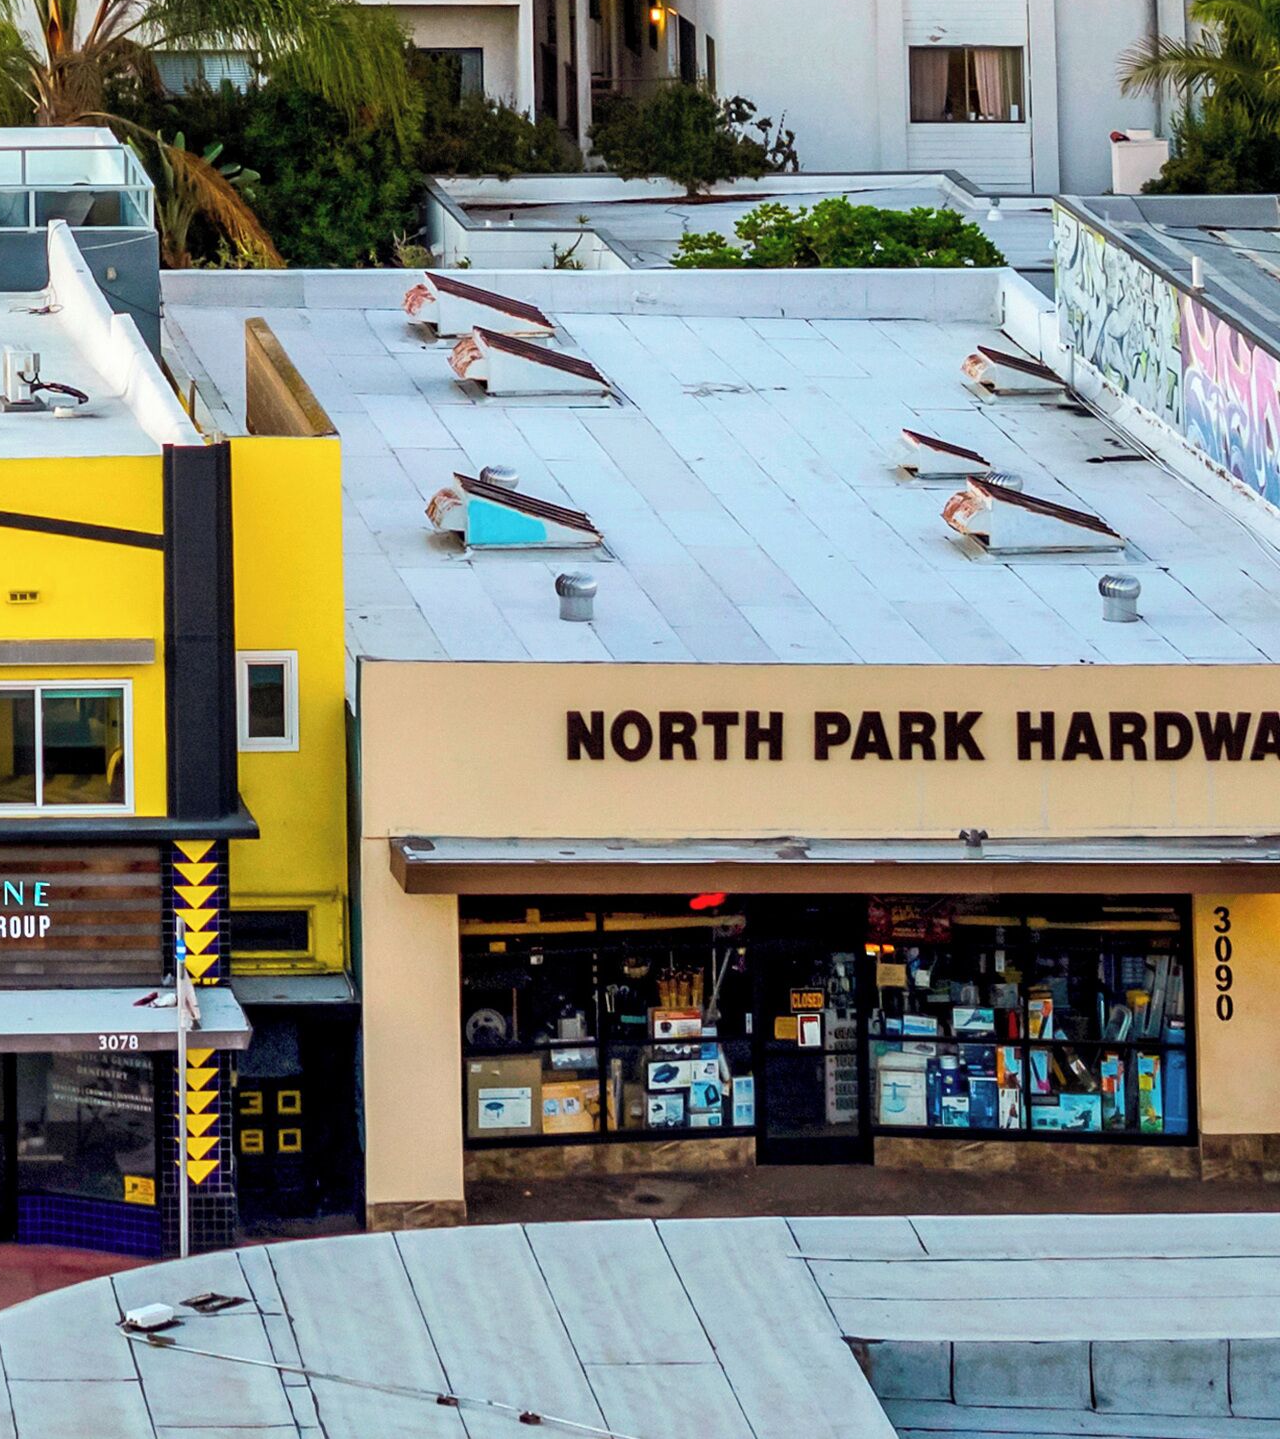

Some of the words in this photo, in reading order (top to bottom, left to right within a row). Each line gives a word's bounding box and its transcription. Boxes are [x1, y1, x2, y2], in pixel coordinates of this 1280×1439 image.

[565, 710, 784, 761] NORTH
[813, 710, 986, 761] PARK
[1016, 710, 1280, 761] HARDWA
[1213, 905, 1234, 1022] 3090
[791, 992, 823, 1009] CLOSED
[98, 1035, 139, 1050] 3078
